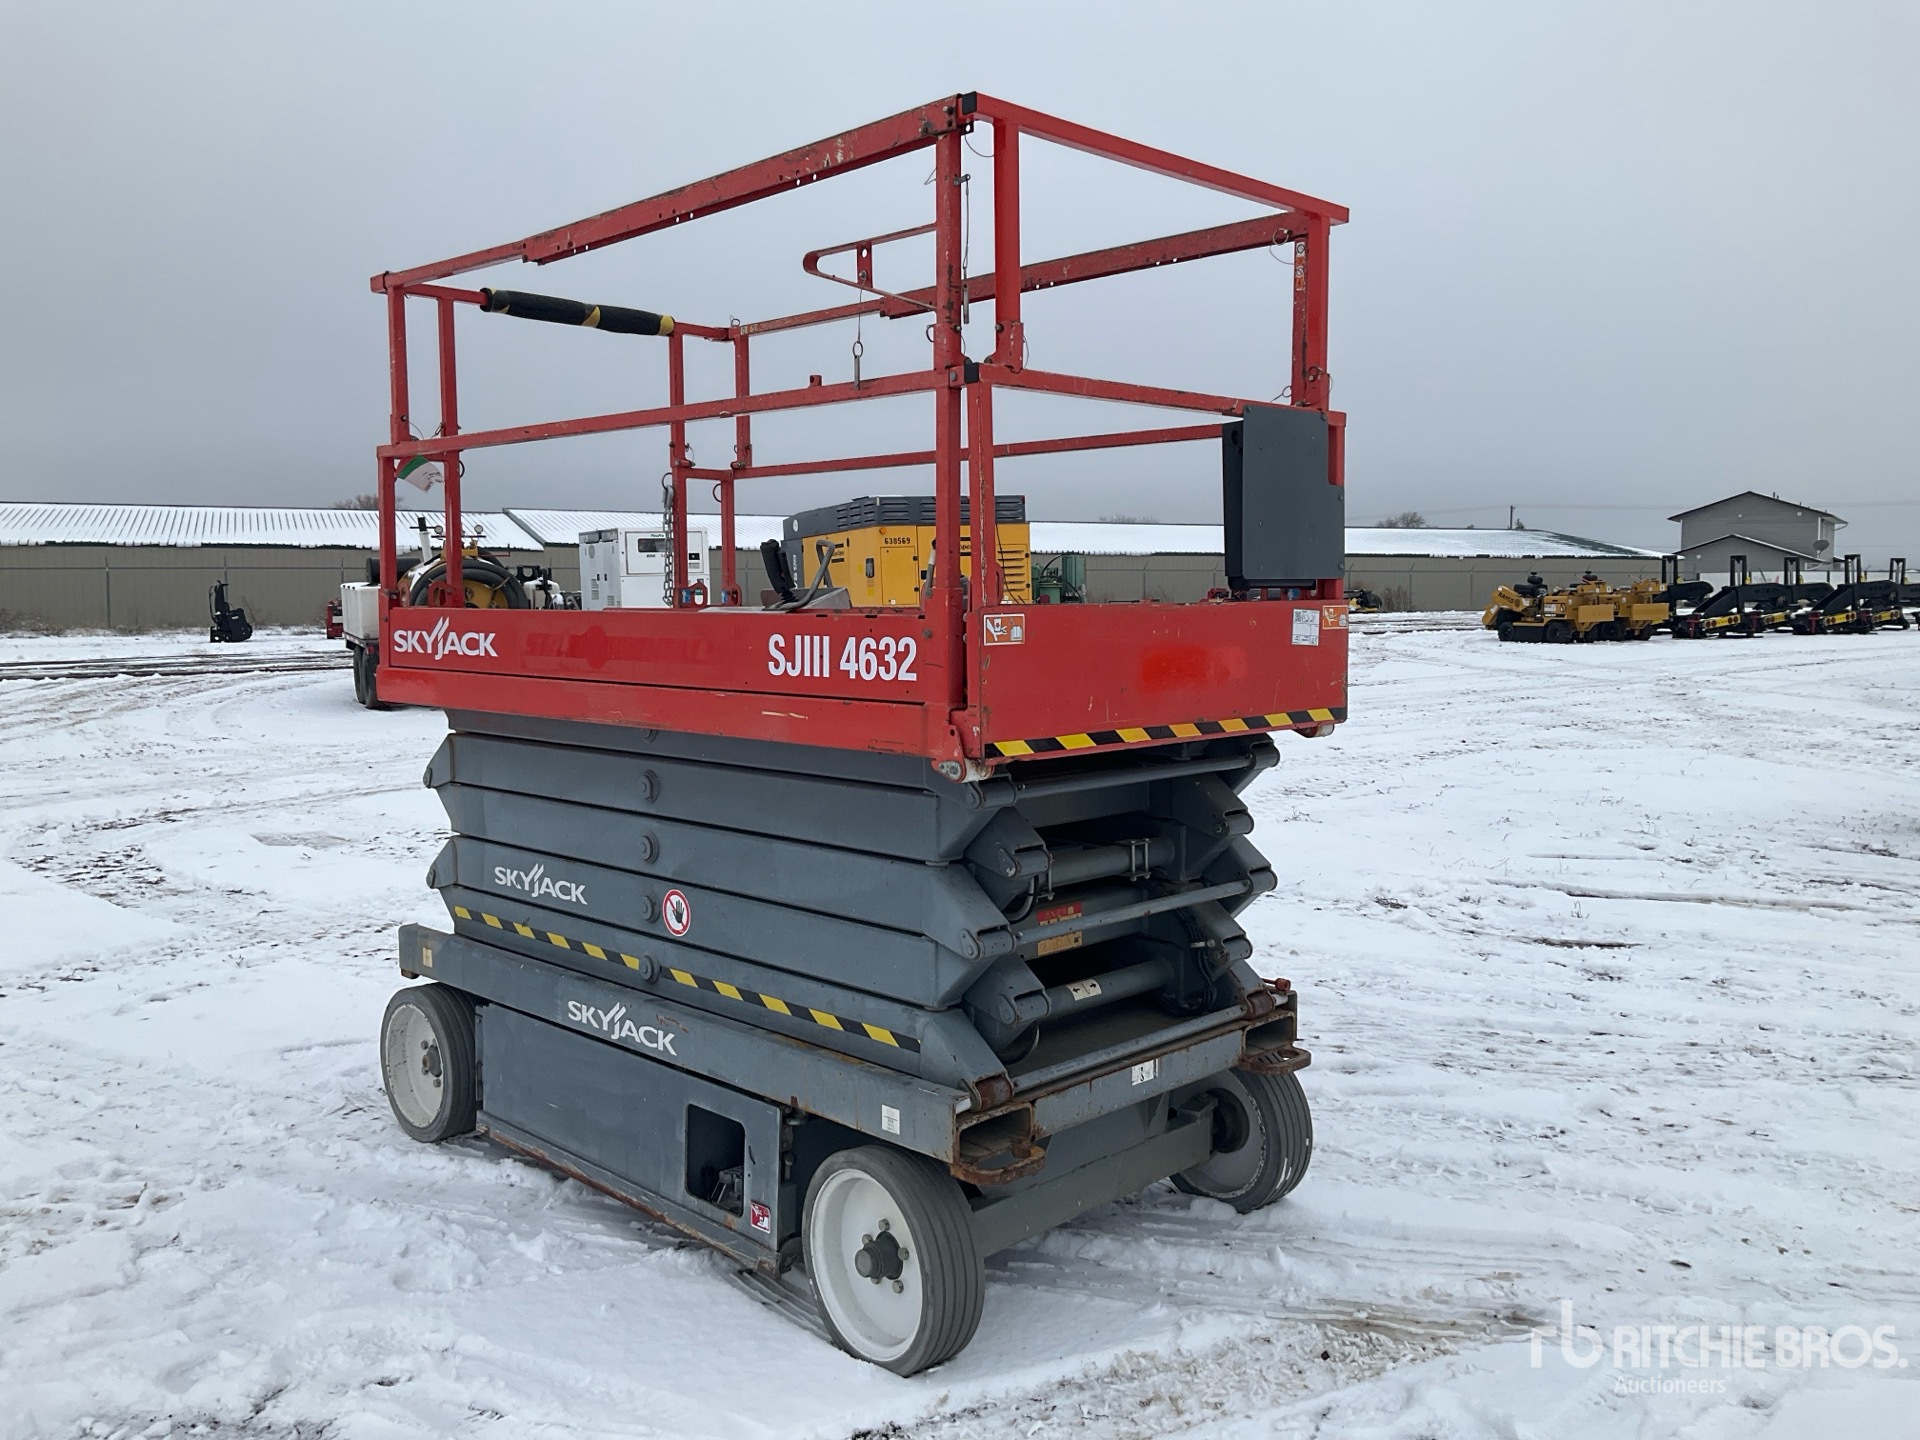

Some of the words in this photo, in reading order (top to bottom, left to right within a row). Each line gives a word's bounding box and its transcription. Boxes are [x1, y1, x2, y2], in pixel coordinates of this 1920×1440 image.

[1498, 591, 1514, 604] RAYCO
[394, 616, 498, 660] SKYJACK
[840, 636, 918, 682] 4632
[494, 863, 588, 905] SKYJACK
[567, 1000, 677, 1056] SKYJACK
